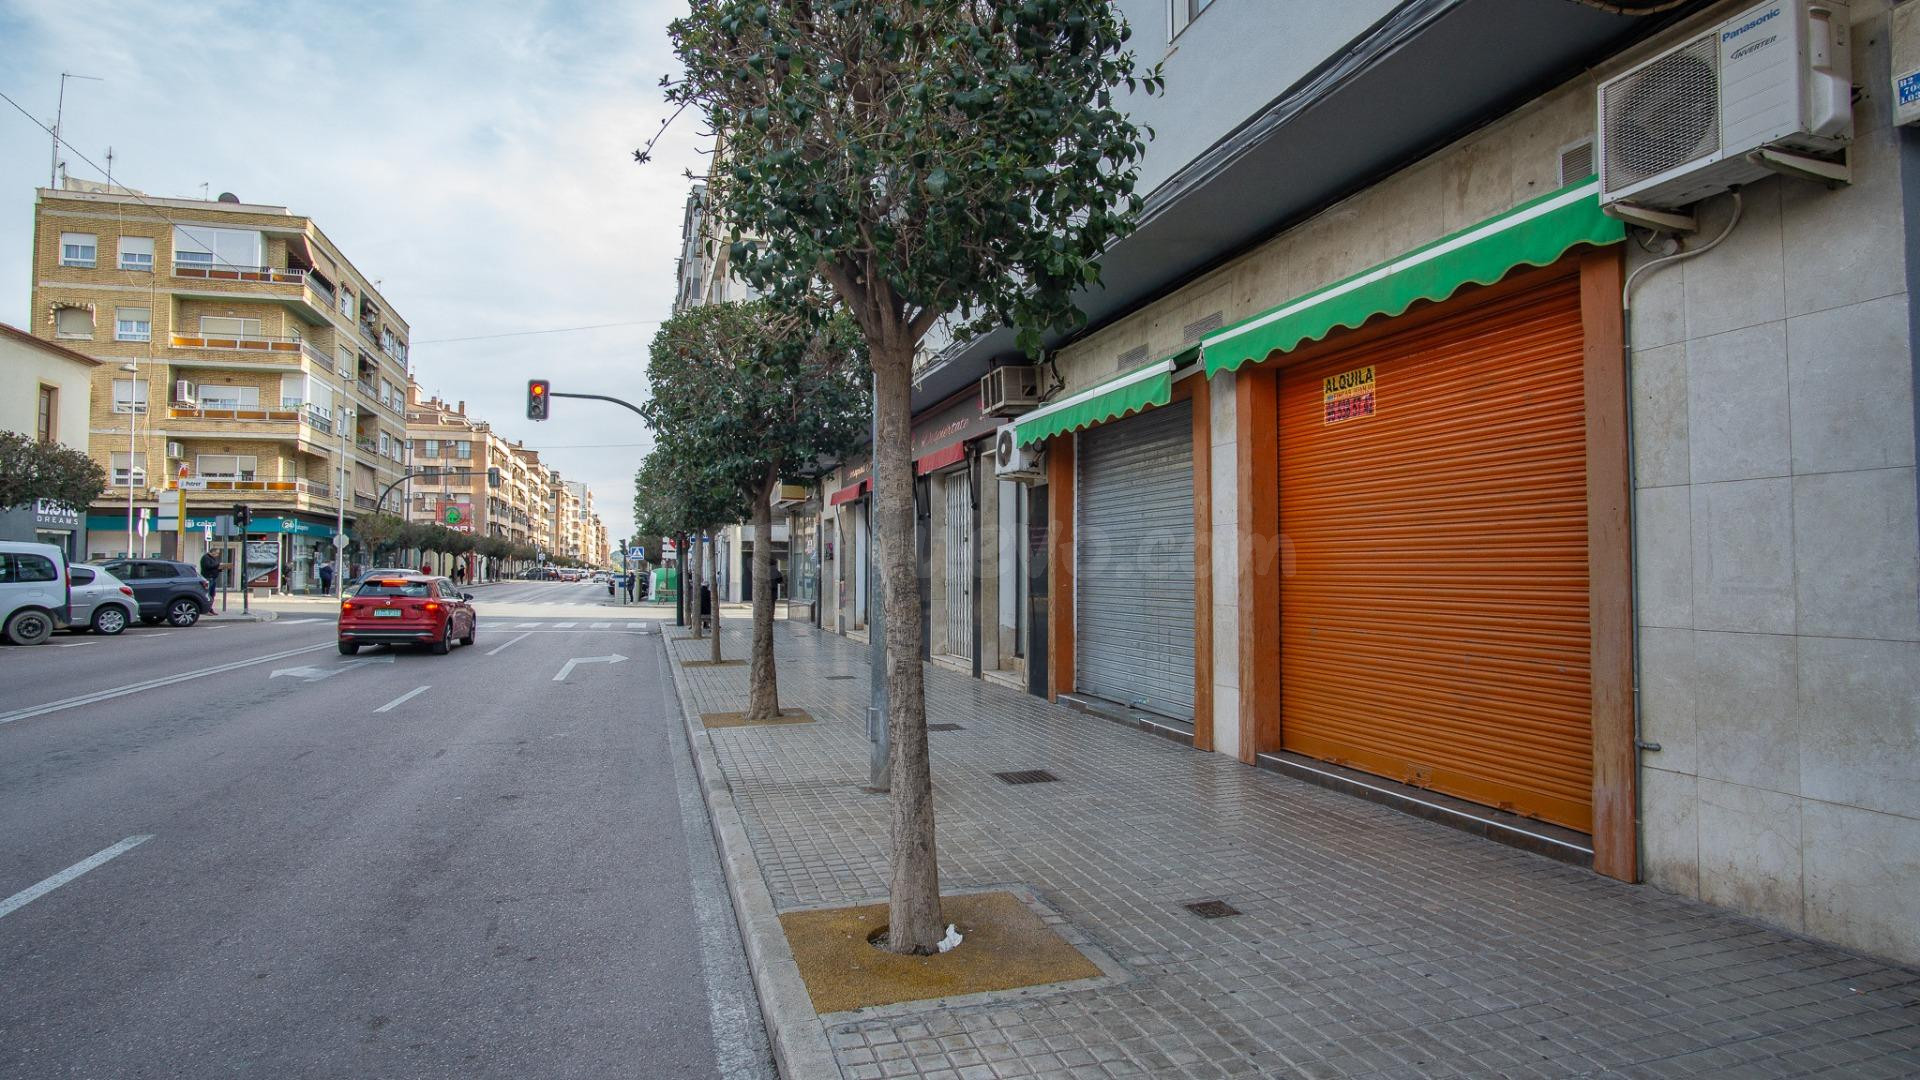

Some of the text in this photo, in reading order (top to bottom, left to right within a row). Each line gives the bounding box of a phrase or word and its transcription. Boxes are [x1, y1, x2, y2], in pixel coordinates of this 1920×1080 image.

[1722, 8, 1781, 42] Panasonic
[1734, 35, 1777, 60] INVERTER
[1325, 367, 1374, 394] ALQUILA
[36, 515, 79, 525] DREAMS
